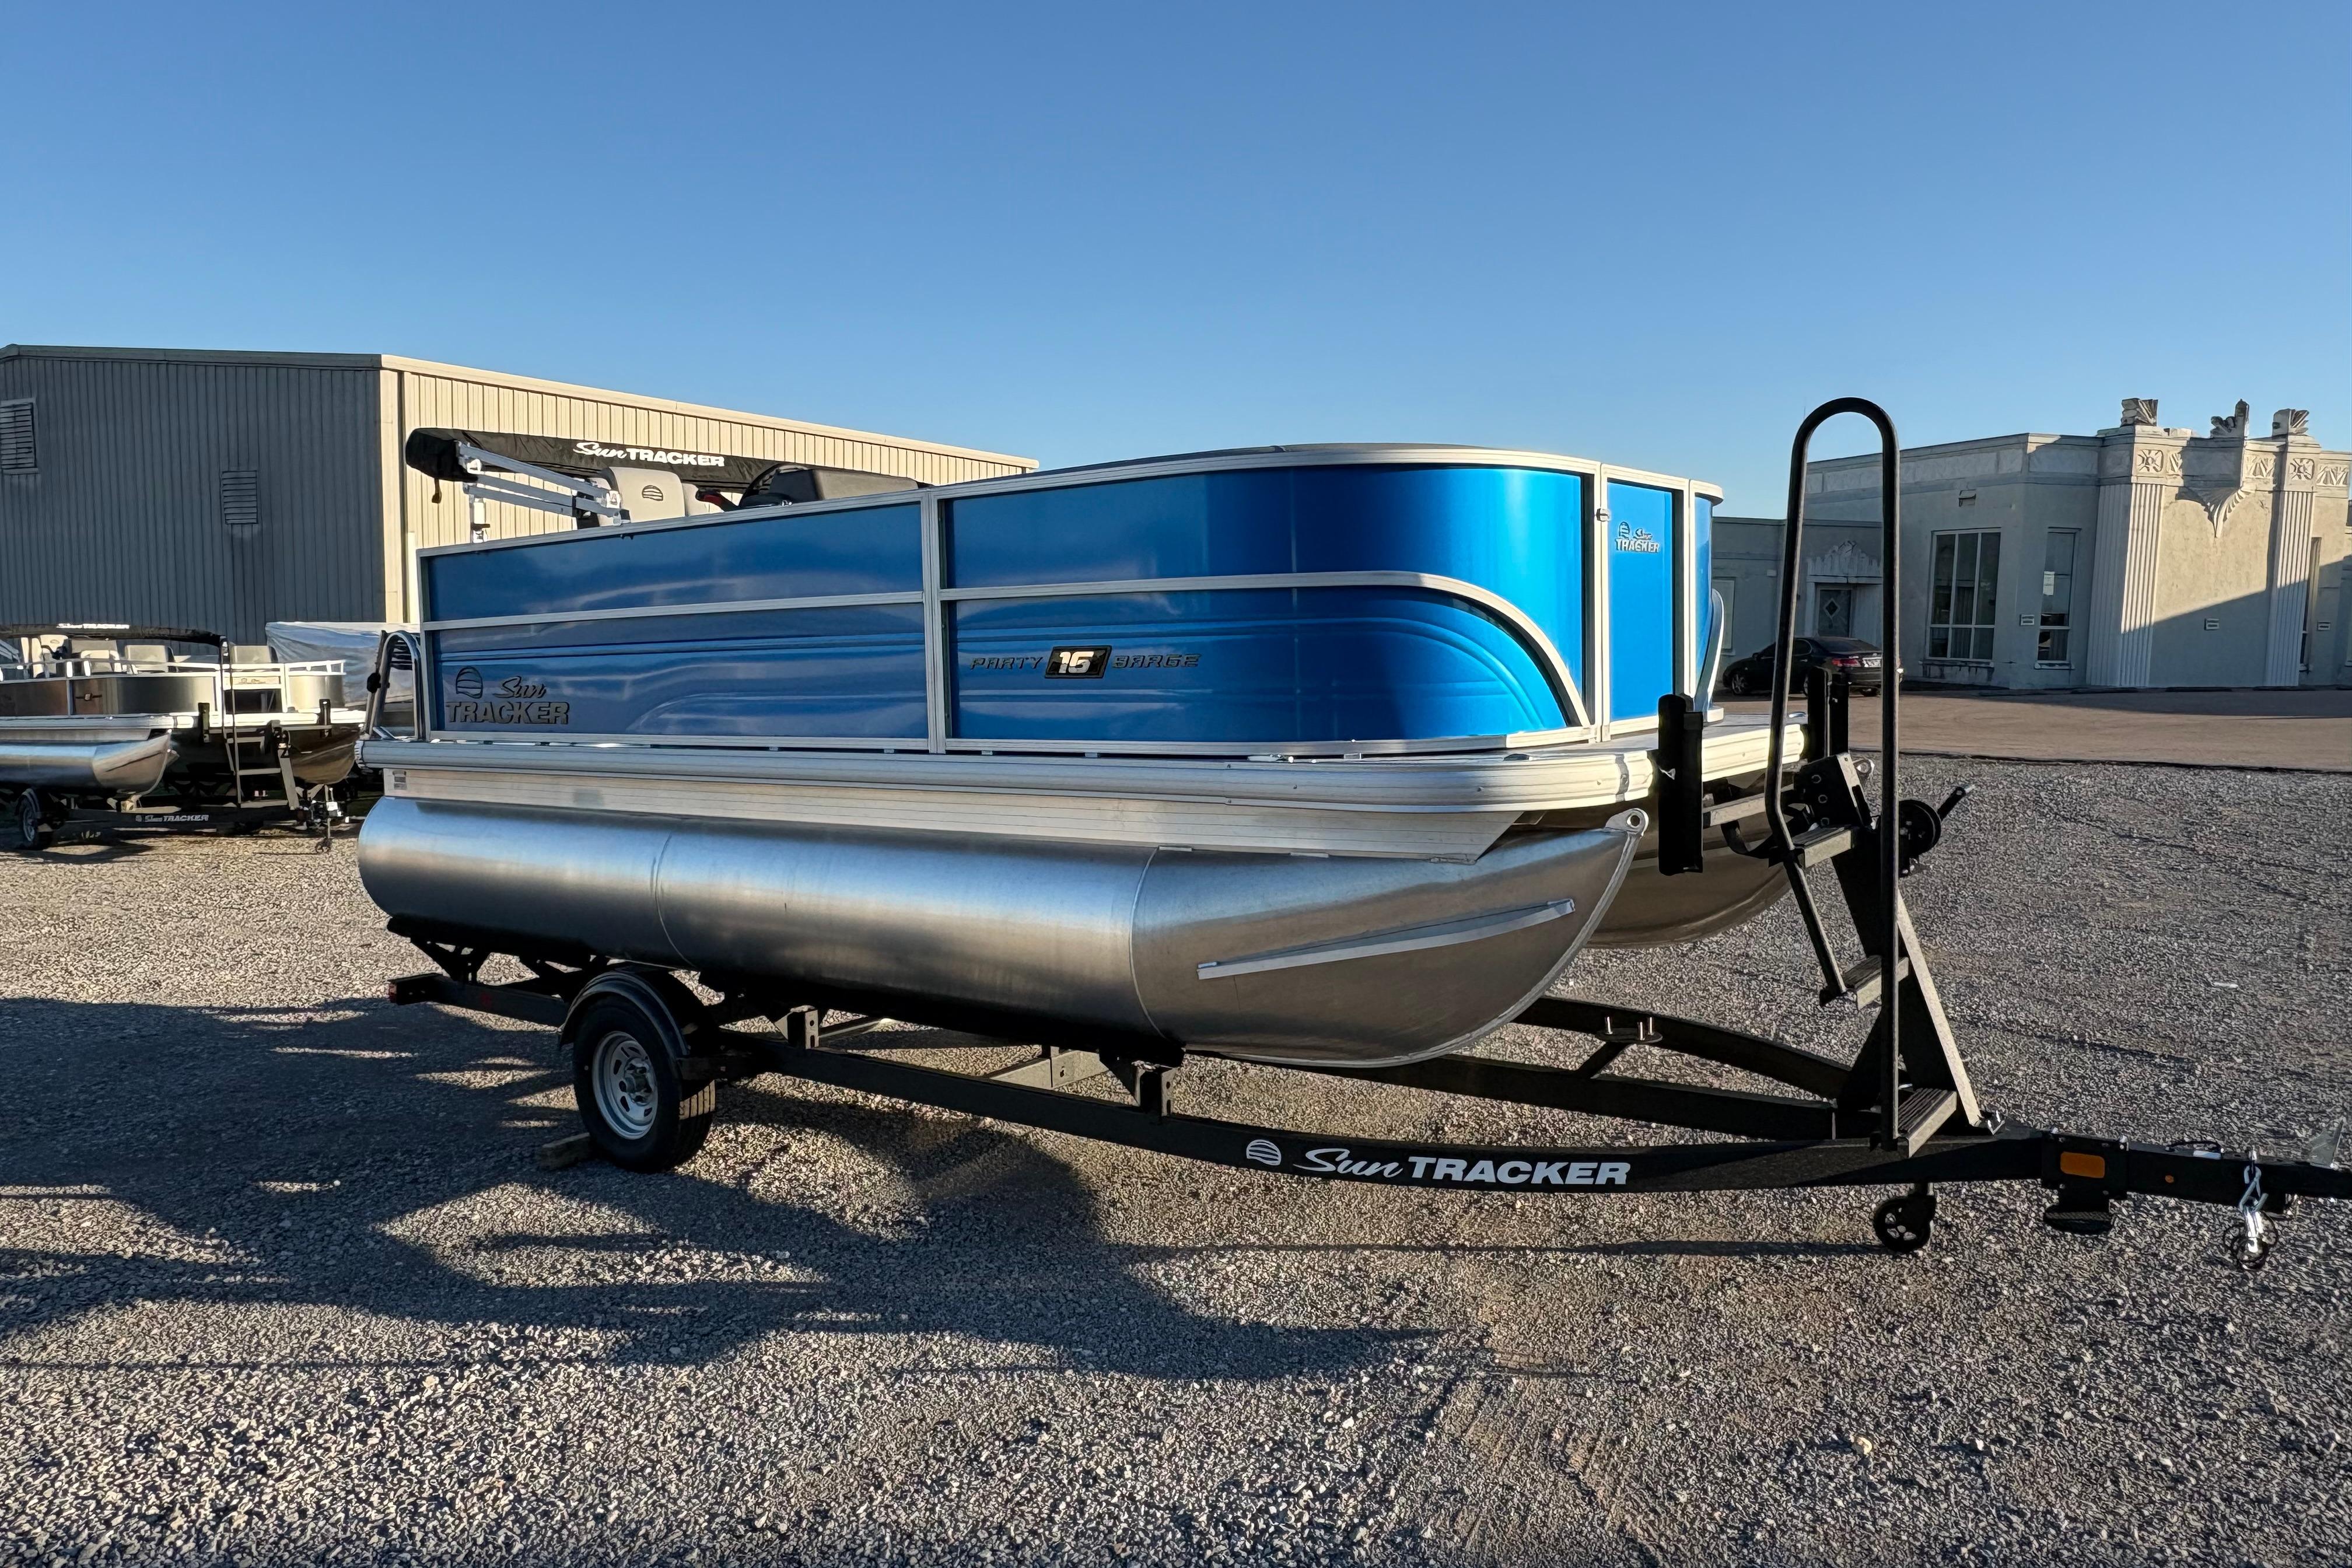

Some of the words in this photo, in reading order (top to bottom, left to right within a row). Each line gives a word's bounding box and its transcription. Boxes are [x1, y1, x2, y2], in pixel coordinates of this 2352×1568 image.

[573, 442, 626, 459] Sun
[626, 447, 724, 467] TRACKER
[971, 656, 1044, 670] PARTY
[1059, 651, 1094, 674] 16
[1112, 653, 1202, 668] BARGE
[492, 676, 547, 699] Sun
[446, 701, 570, 725] TRACKER
[1293, 1148, 1403, 1177] Sun
[1408, 1156, 1632, 1185] TRACKER
